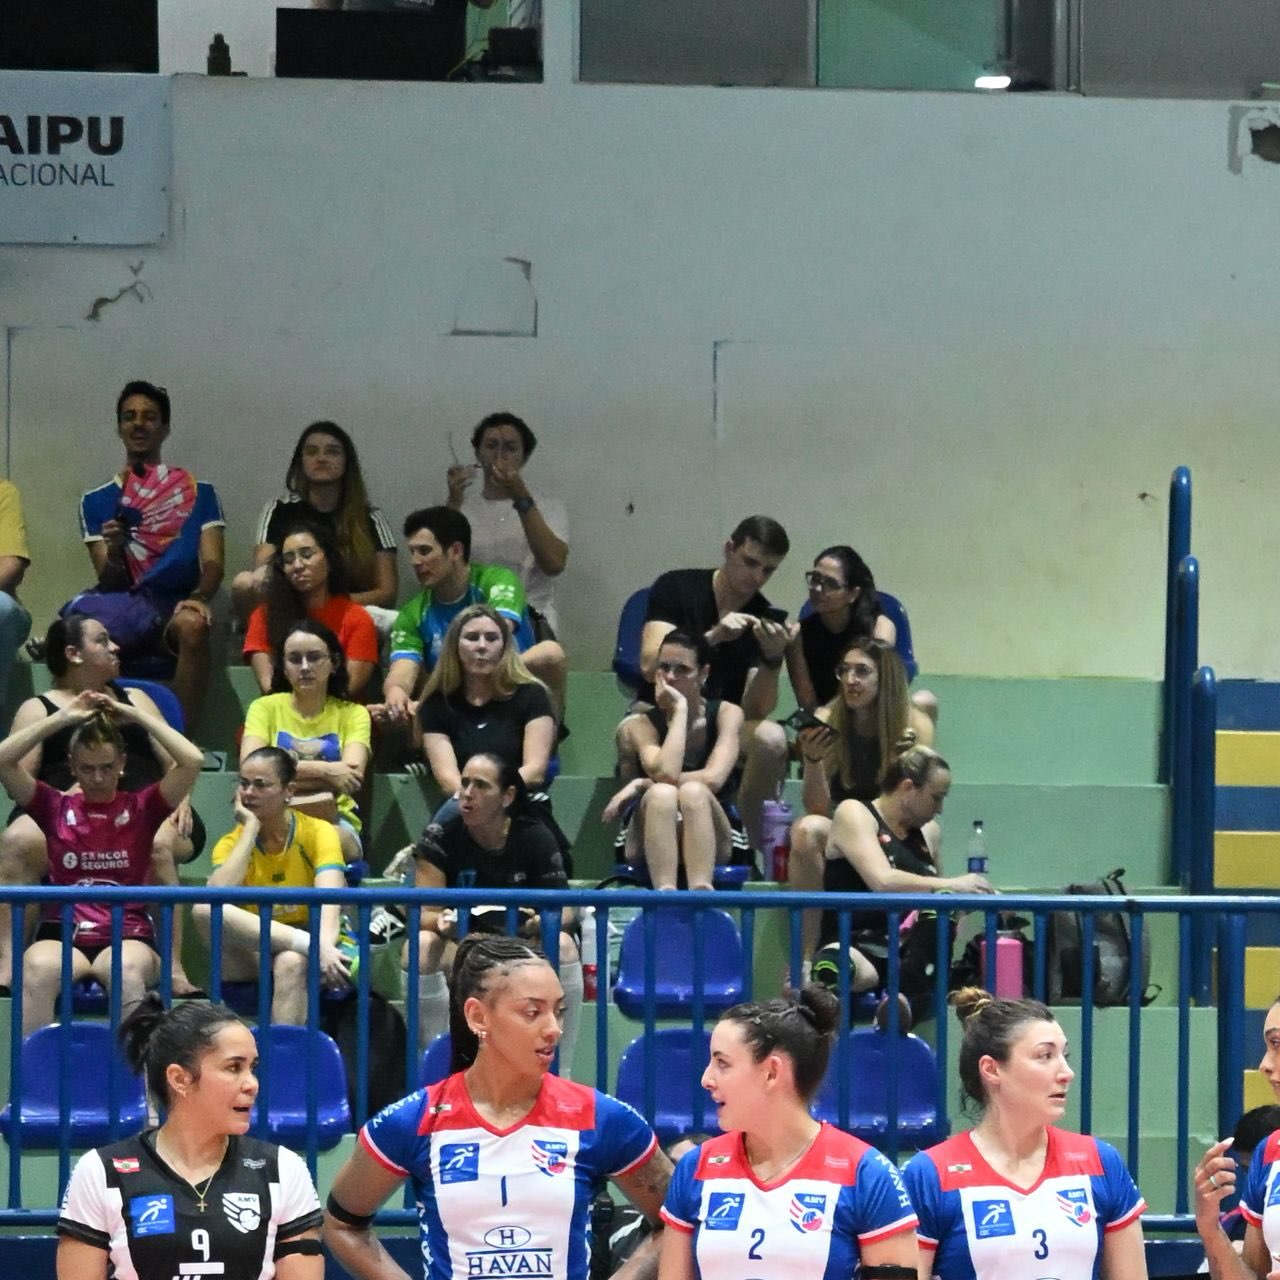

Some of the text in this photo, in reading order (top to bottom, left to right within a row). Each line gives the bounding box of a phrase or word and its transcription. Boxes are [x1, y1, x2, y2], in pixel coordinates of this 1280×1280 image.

[81, 860, 130, 870] SEGUROS
[875, 1155, 910, 1208] HAVAN
[190, 1228, 210, 1262] 9
[499, 1229, 516, 1246] H
[748, 1227, 766, 1260] 2
[1032, 1228, 1049, 1260] 3
[467, 1253, 552, 1276] HAVAN
